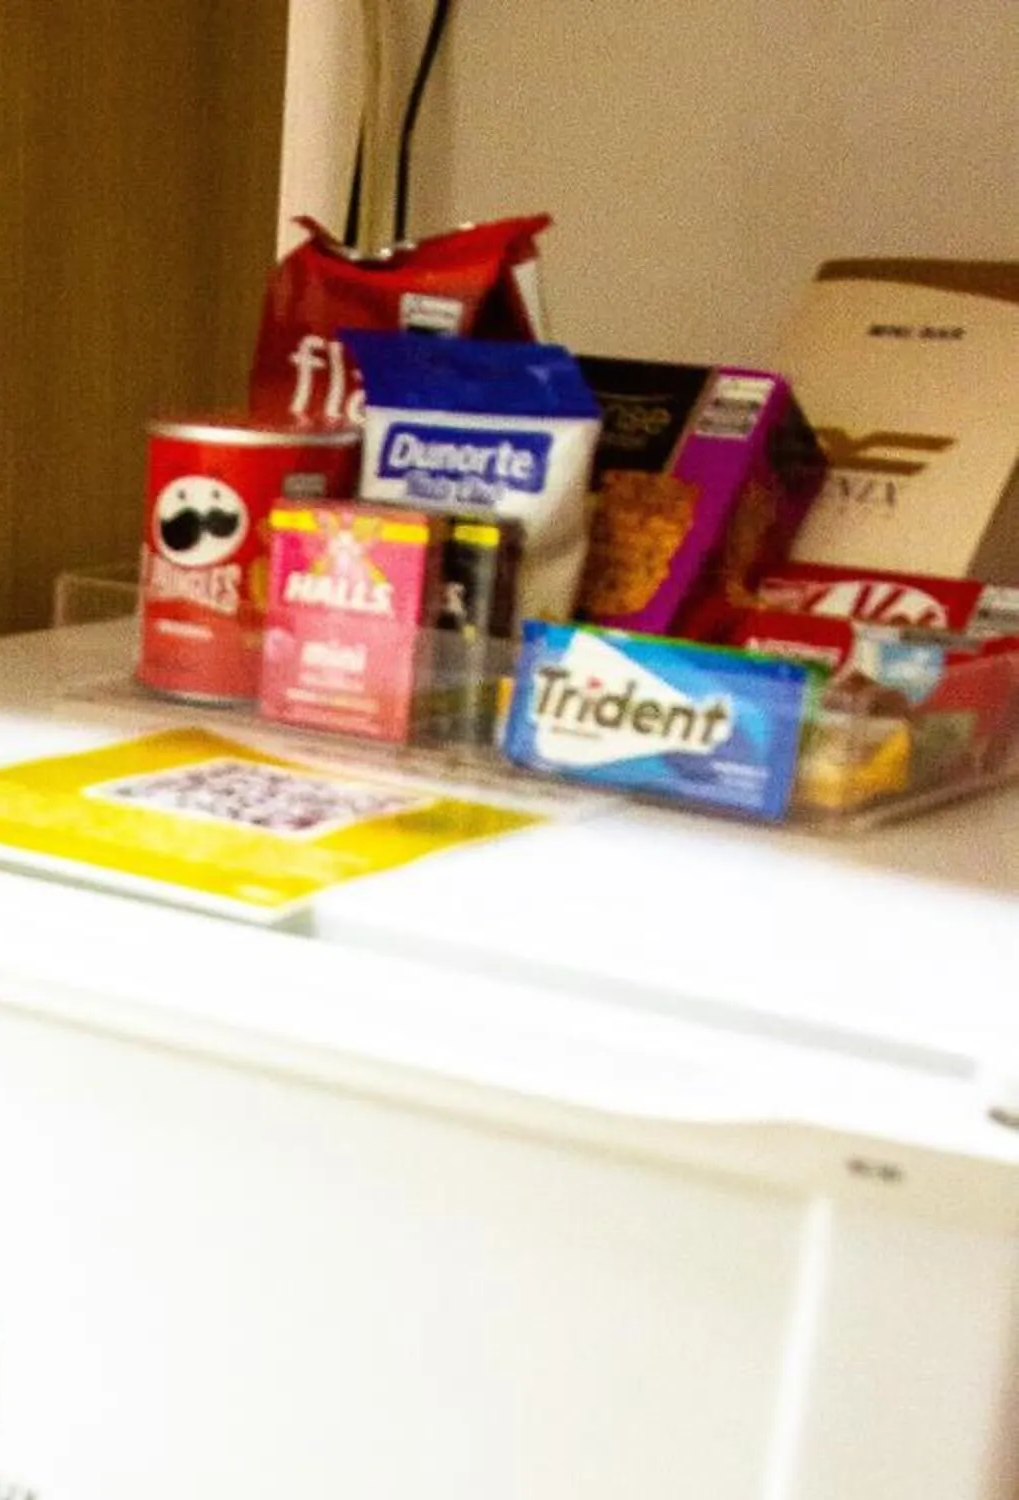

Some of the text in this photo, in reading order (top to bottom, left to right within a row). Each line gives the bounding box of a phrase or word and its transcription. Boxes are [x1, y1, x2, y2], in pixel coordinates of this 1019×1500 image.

[389, 432, 534, 481] Dunorte
[283, 570, 396, 617] HALLS
[537, 665, 728, 745] Trident
